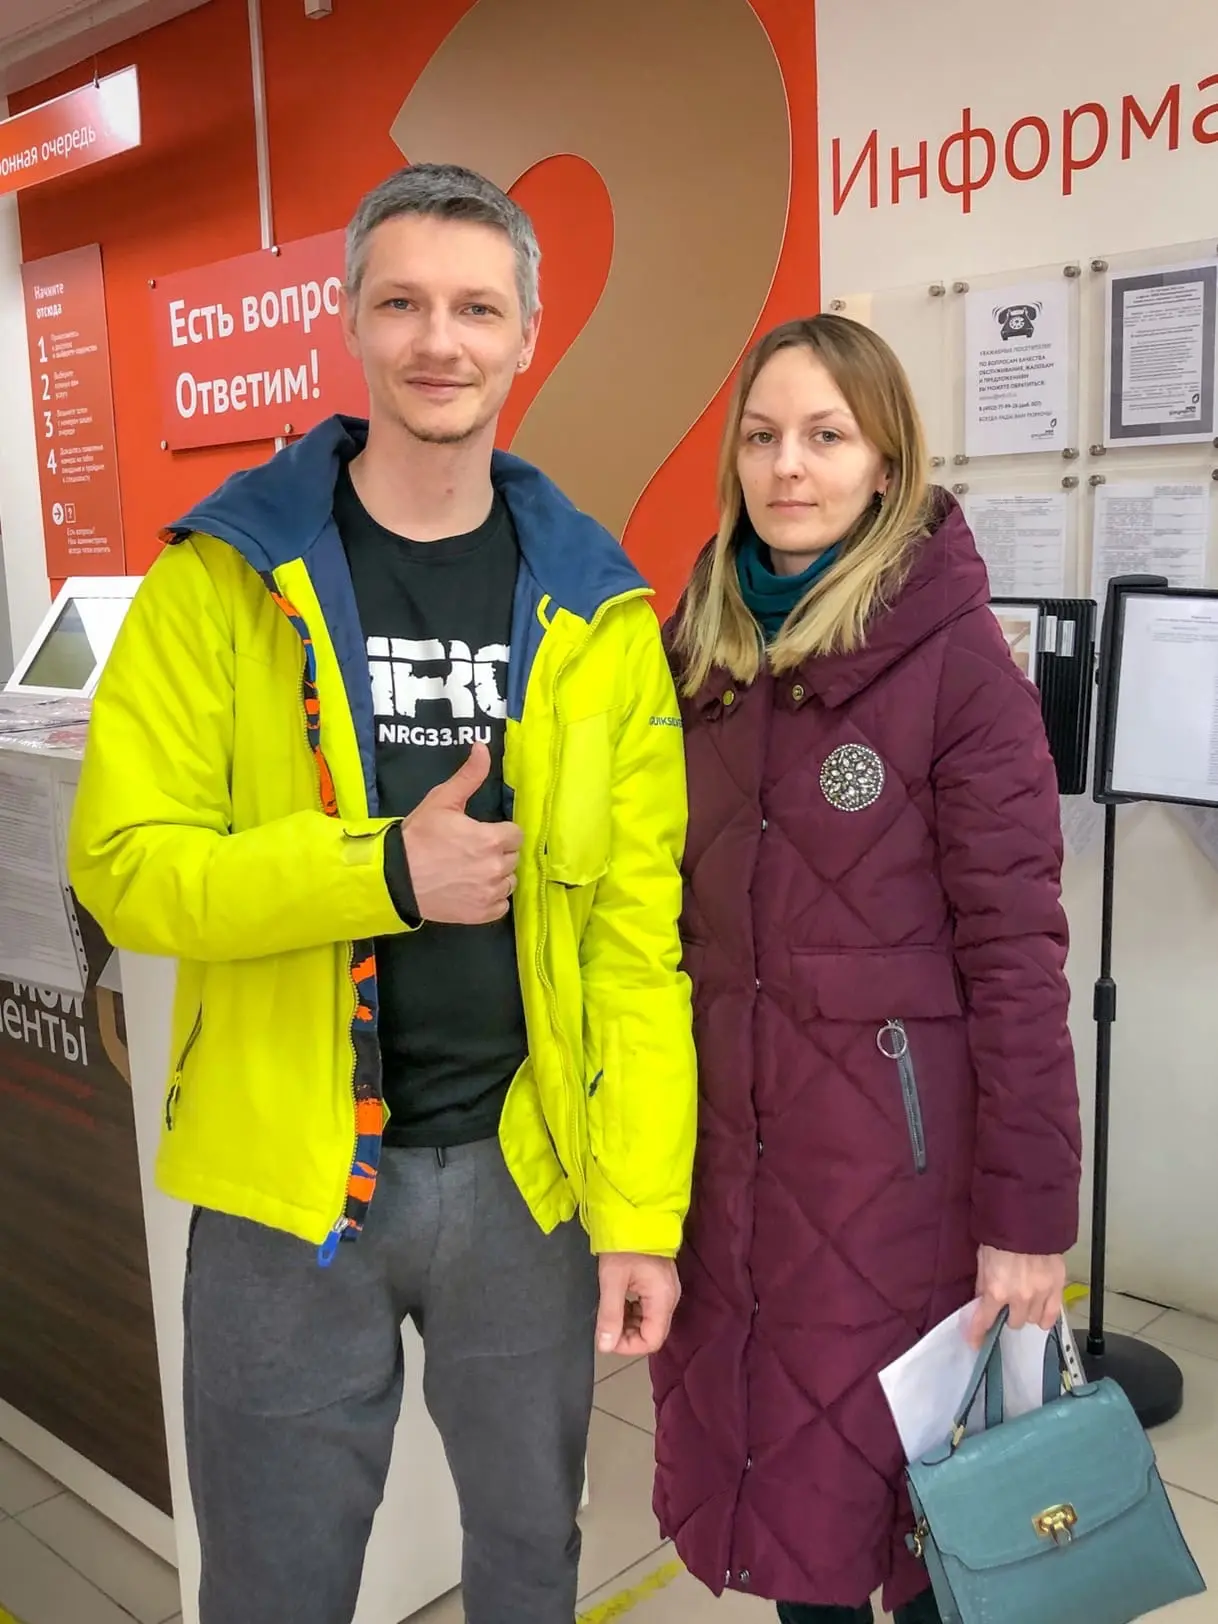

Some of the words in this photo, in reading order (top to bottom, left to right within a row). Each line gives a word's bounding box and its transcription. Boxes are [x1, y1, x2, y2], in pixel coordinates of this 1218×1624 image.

[41, 124, 97, 162] очередь
[831, 74, 1218, 216] Информа
[169, 299, 235, 348] Есть
[242, 276, 342, 335] вопро
[37, 335, 49, 363] 1
[40, 373, 52, 401] 2
[176, 348, 321, 420] Ответим!
[43, 410, 54, 438] 3
[46, 448, 58, 476] 4
[378, 723, 492, 747] NRG33.RU
[0, 999, 88, 1066] енты
